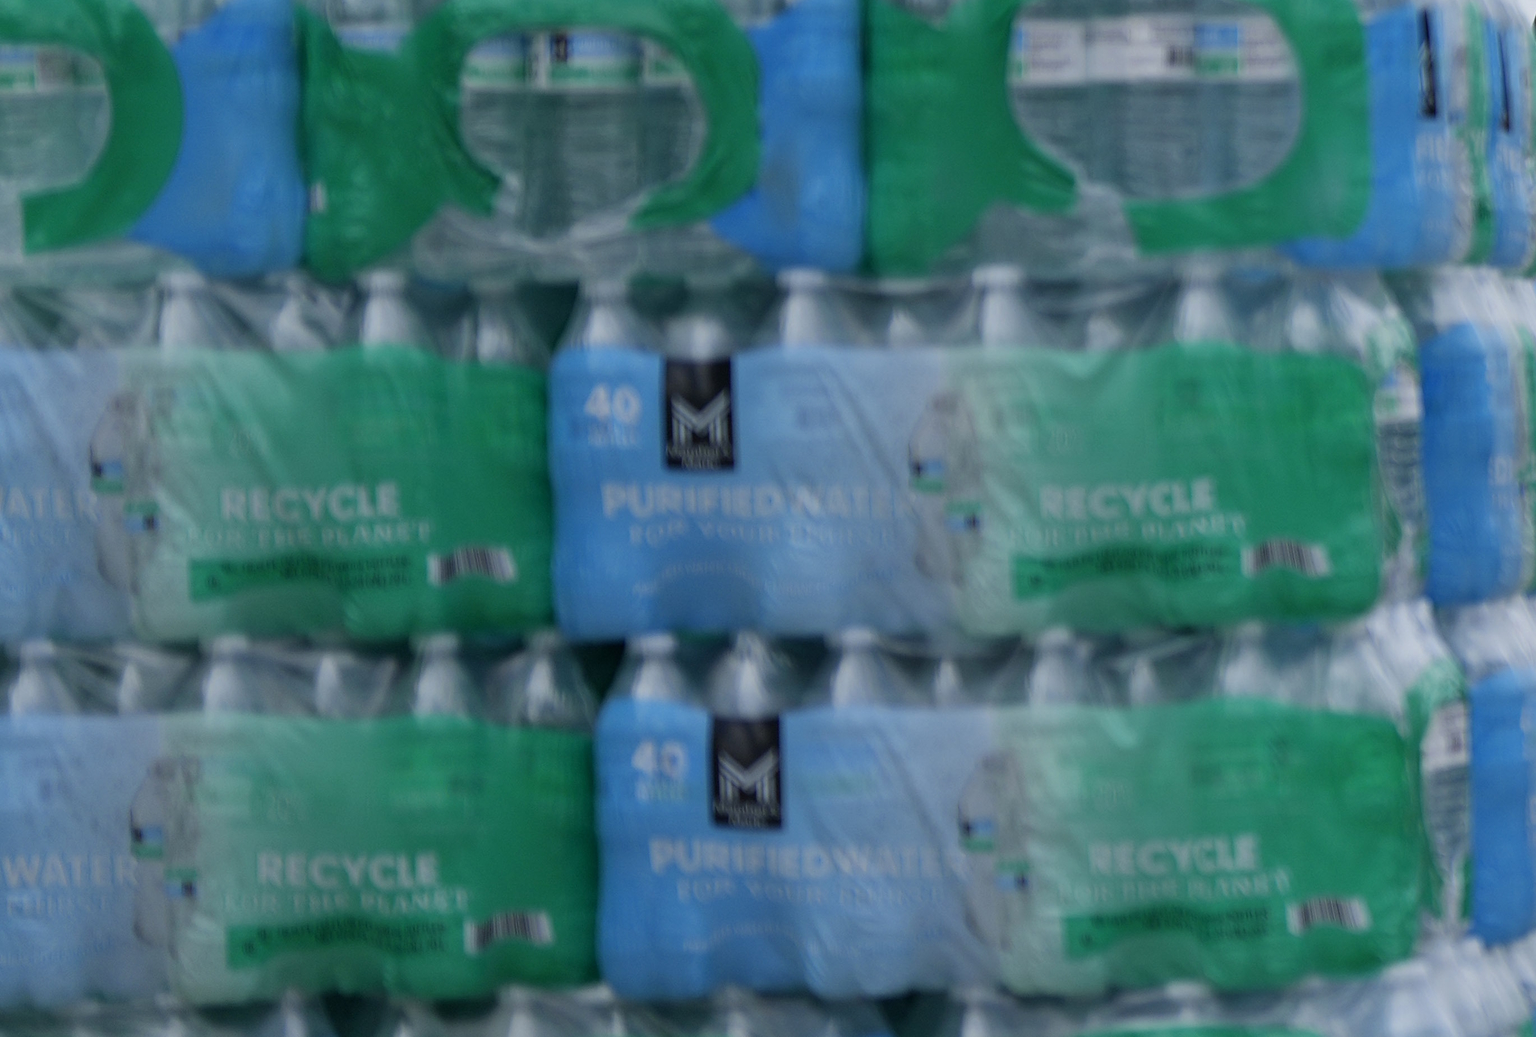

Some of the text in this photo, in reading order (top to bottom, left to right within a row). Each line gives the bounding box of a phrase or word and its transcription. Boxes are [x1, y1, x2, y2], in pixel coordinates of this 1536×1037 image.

[584, 383, 642, 426] 40
[0, 486, 98, 520] ATER
[220, 482, 399, 522] RECYCLE
[602, 481, 786, 520] PURIFIED
[1040, 476, 1215, 520] RECYCLE
[631, 740, 687, 782] 40
[2, 855, 139, 886] WATER
[257, 850, 438, 890] RECYCLE
[1088, 834, 1259, 875] RECYCLE
